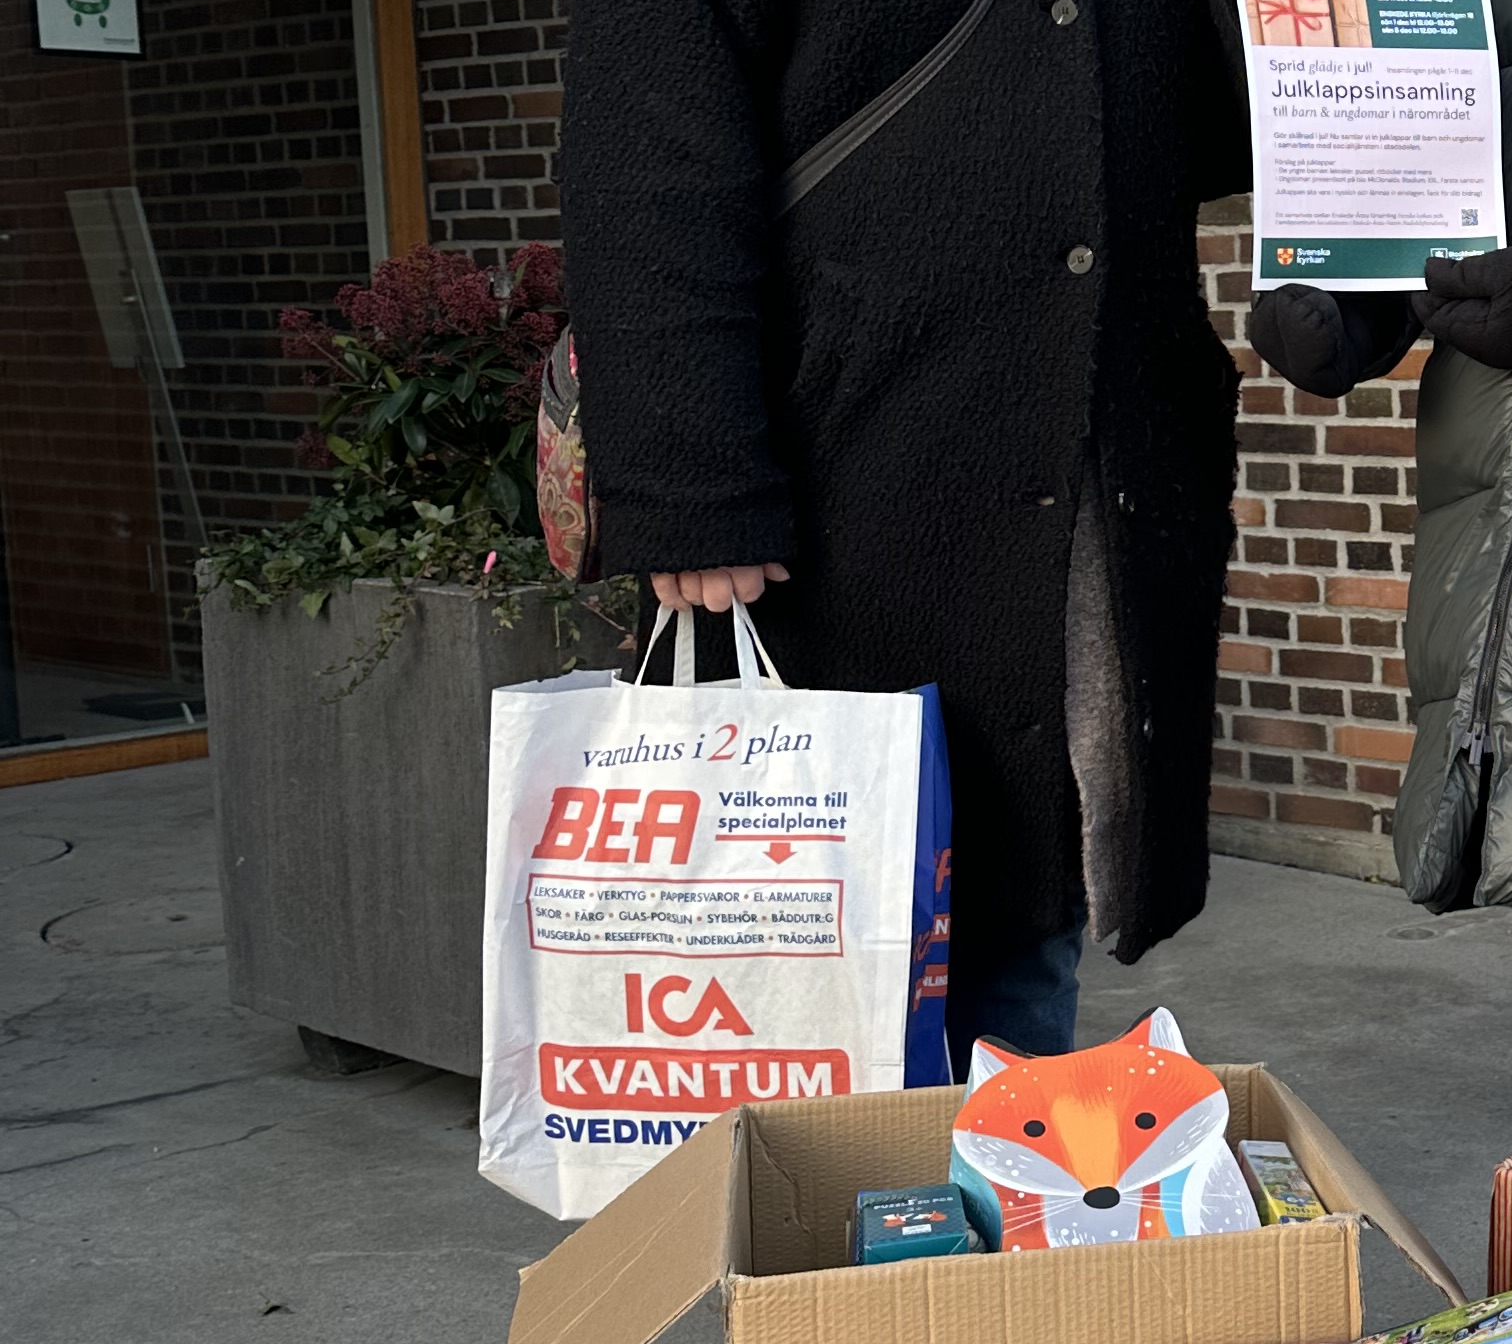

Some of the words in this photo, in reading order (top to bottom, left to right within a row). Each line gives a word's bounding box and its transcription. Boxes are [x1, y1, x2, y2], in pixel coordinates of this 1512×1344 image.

[1270, 59, 1304, 73] Sprid
[1309, 59, 1343, 74] glädje
[1271, 79, 1475, 106] Julklappsinsamling
[1291, 105, 1316, 117] barn
[1334, 106, 1389, 121] ungdomar
[1399, 107, 1470, 119] närområdet
[583, 734, 685, 768] varuhus
[692, 733, 706, 759] i
[707, 723, 738, 762] 2
[741, 724, 812, 765] plan
[719, 792, 817, 807] Välkomna
[824, 792, 847, 807] till
[532, 786, 701, 864] BEA
[718, 813, 847, 832] specialplanet
[534, 887, 586, 900] LEKSAKER
[597, 890, 646, 901] VERKTYG
[660, 891, 740, 903] PAPPERSVAROR
[753, 892, 832, 903] EL-ARMATURER
[535, 907, 562, 919] SKOR
[575, 909, 605, 921] FÄRG
[619, 911, 692, 925] GLAS-PORSLIN
[707, 911, 758, 923] SYBEHÖR
[537, 928, 591, 942] HUSGERÅD
[686, 932, 764, 945] UNDERKLÄDER
[778, 932, 836, 944] TRÄDGÅRD
[624, 973, 755, 1037] ICA
[554, 1056, 833, 1099] KVANTUM
[544, 1113, 712, 1145] SVEDMY
